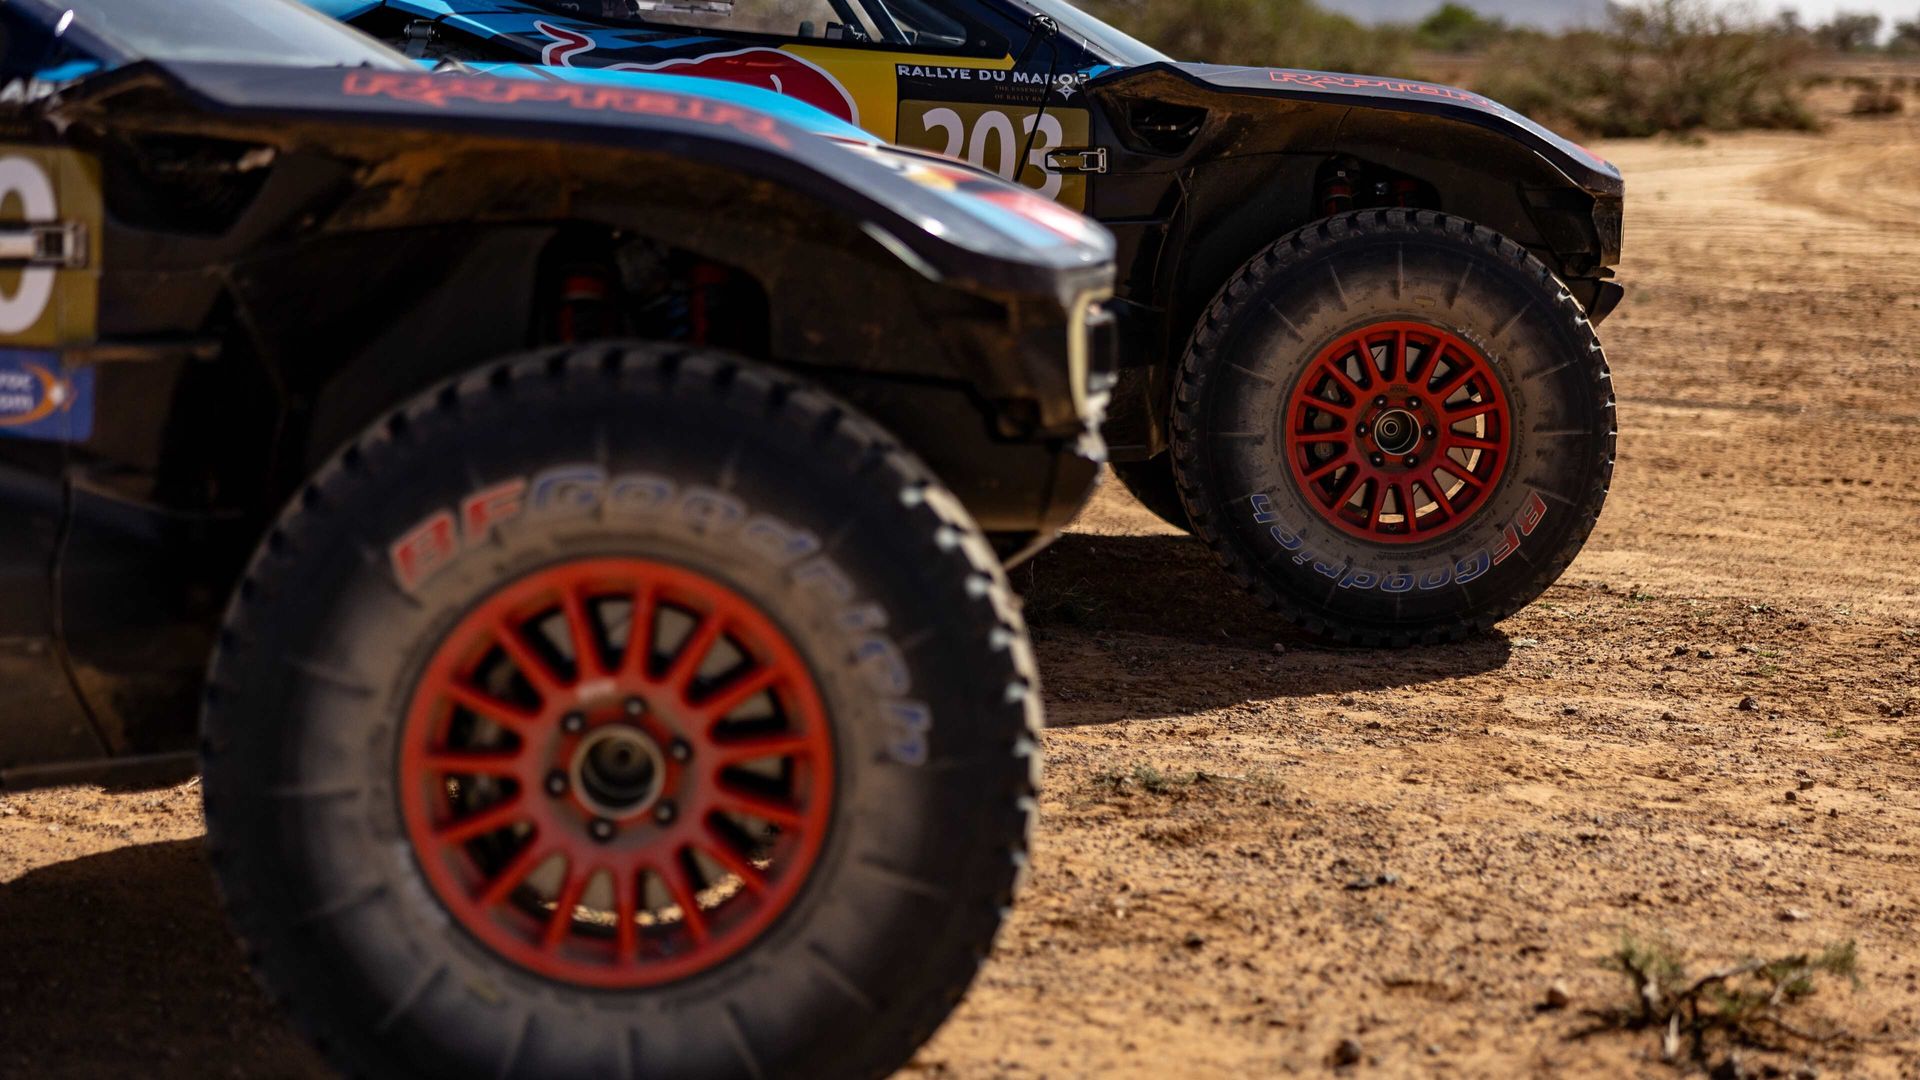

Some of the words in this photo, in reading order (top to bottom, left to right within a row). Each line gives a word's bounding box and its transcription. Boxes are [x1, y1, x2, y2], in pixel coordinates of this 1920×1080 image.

[897, 64, 971, 80] RALLYE
[979, 69, 1006, 82] DU
[922, 107, 1063, 201] 203
[1250, 491, 1548, 593] BFGoodrich
[389, 464, 931, 766] BFGoodrich
